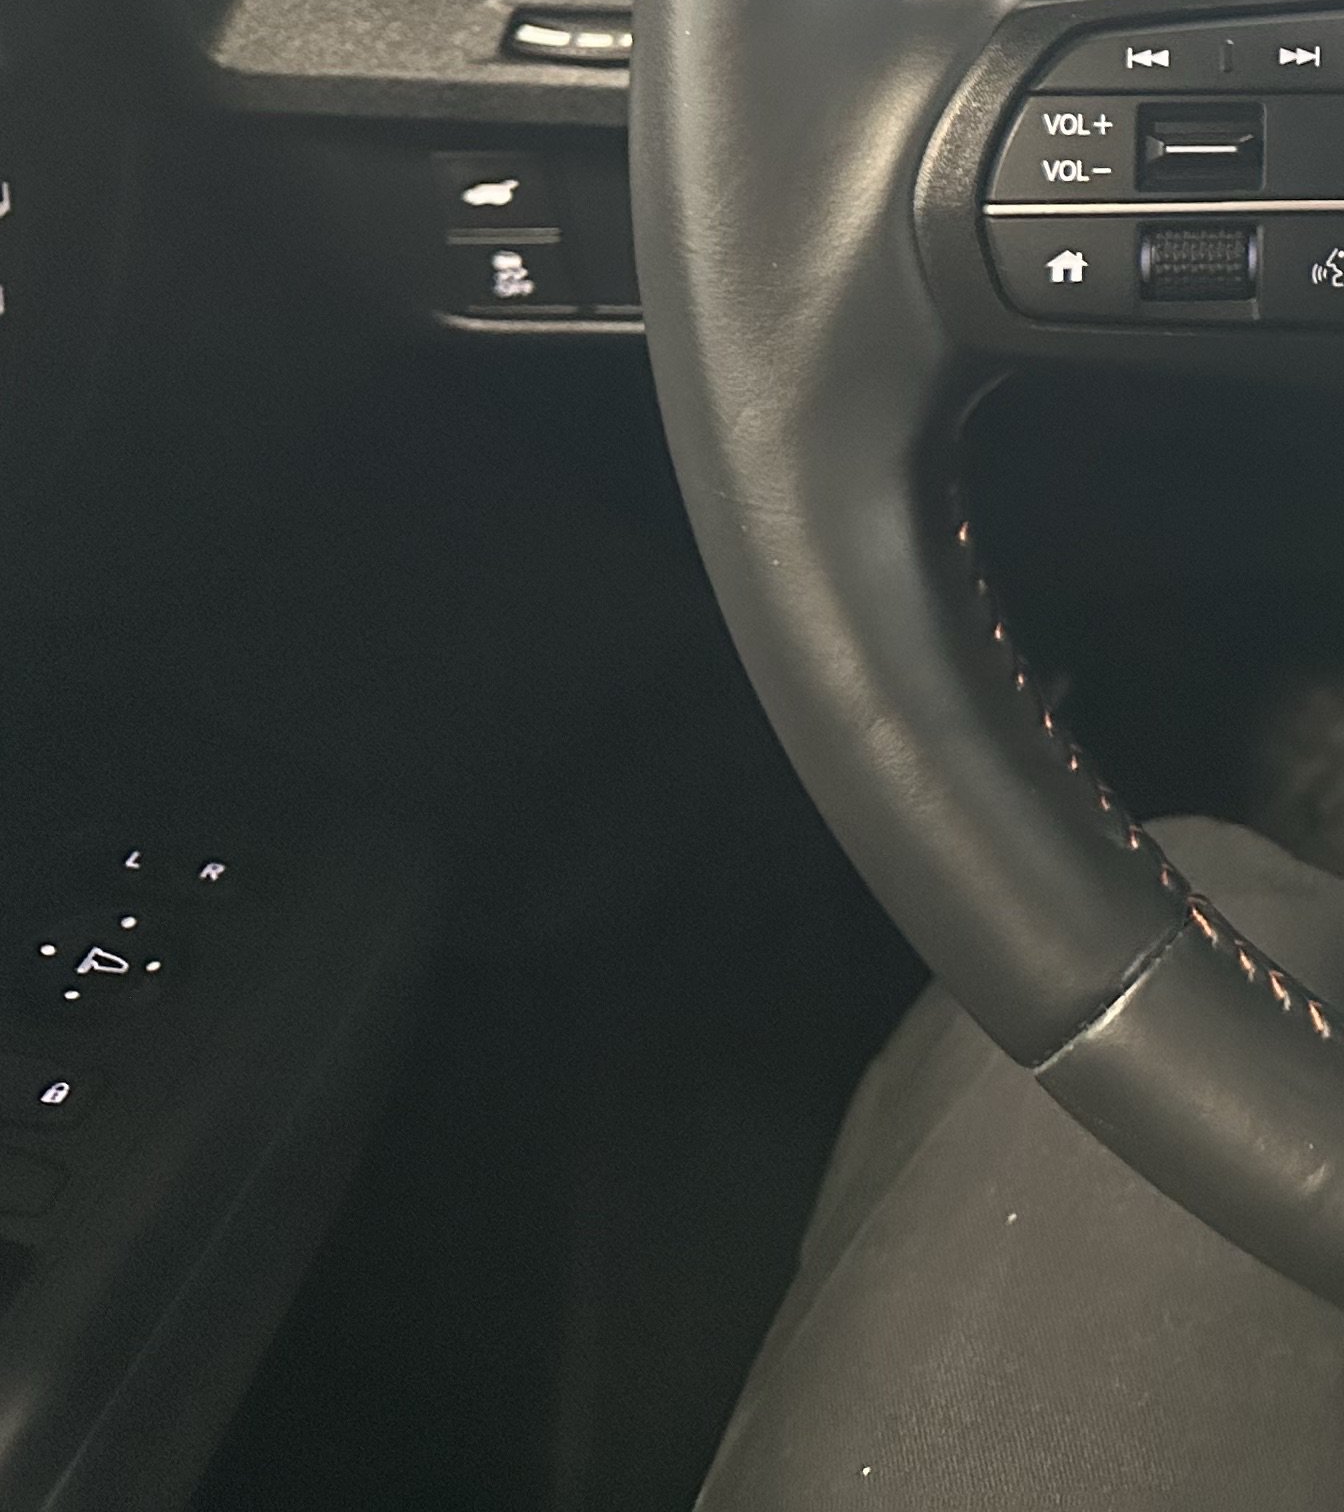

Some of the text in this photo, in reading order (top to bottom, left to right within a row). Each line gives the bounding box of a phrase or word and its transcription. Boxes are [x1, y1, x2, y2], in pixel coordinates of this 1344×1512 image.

[1043, 114, 1113, 137] VOL+
[124, 850, 142, 869] L
[199, 862, 226, 881] R
